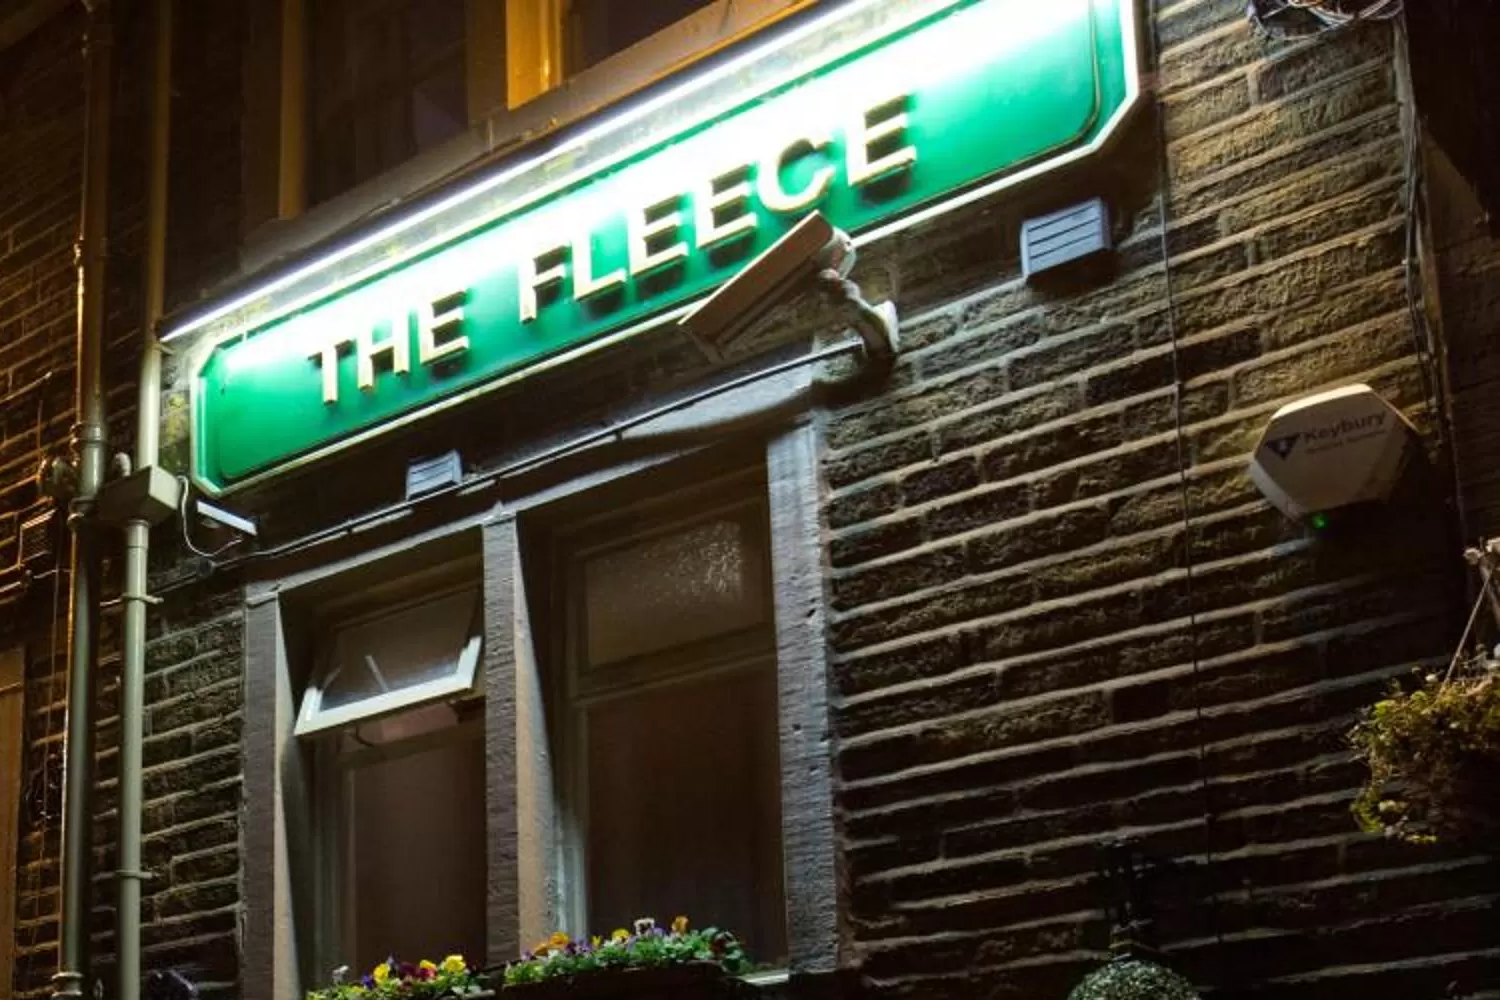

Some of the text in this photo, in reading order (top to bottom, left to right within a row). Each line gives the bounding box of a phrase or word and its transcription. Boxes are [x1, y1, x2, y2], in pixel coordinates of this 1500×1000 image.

[307, 80, 917, 405] THE FLEECE
[1304, 409, 1387, 443] Keybury
